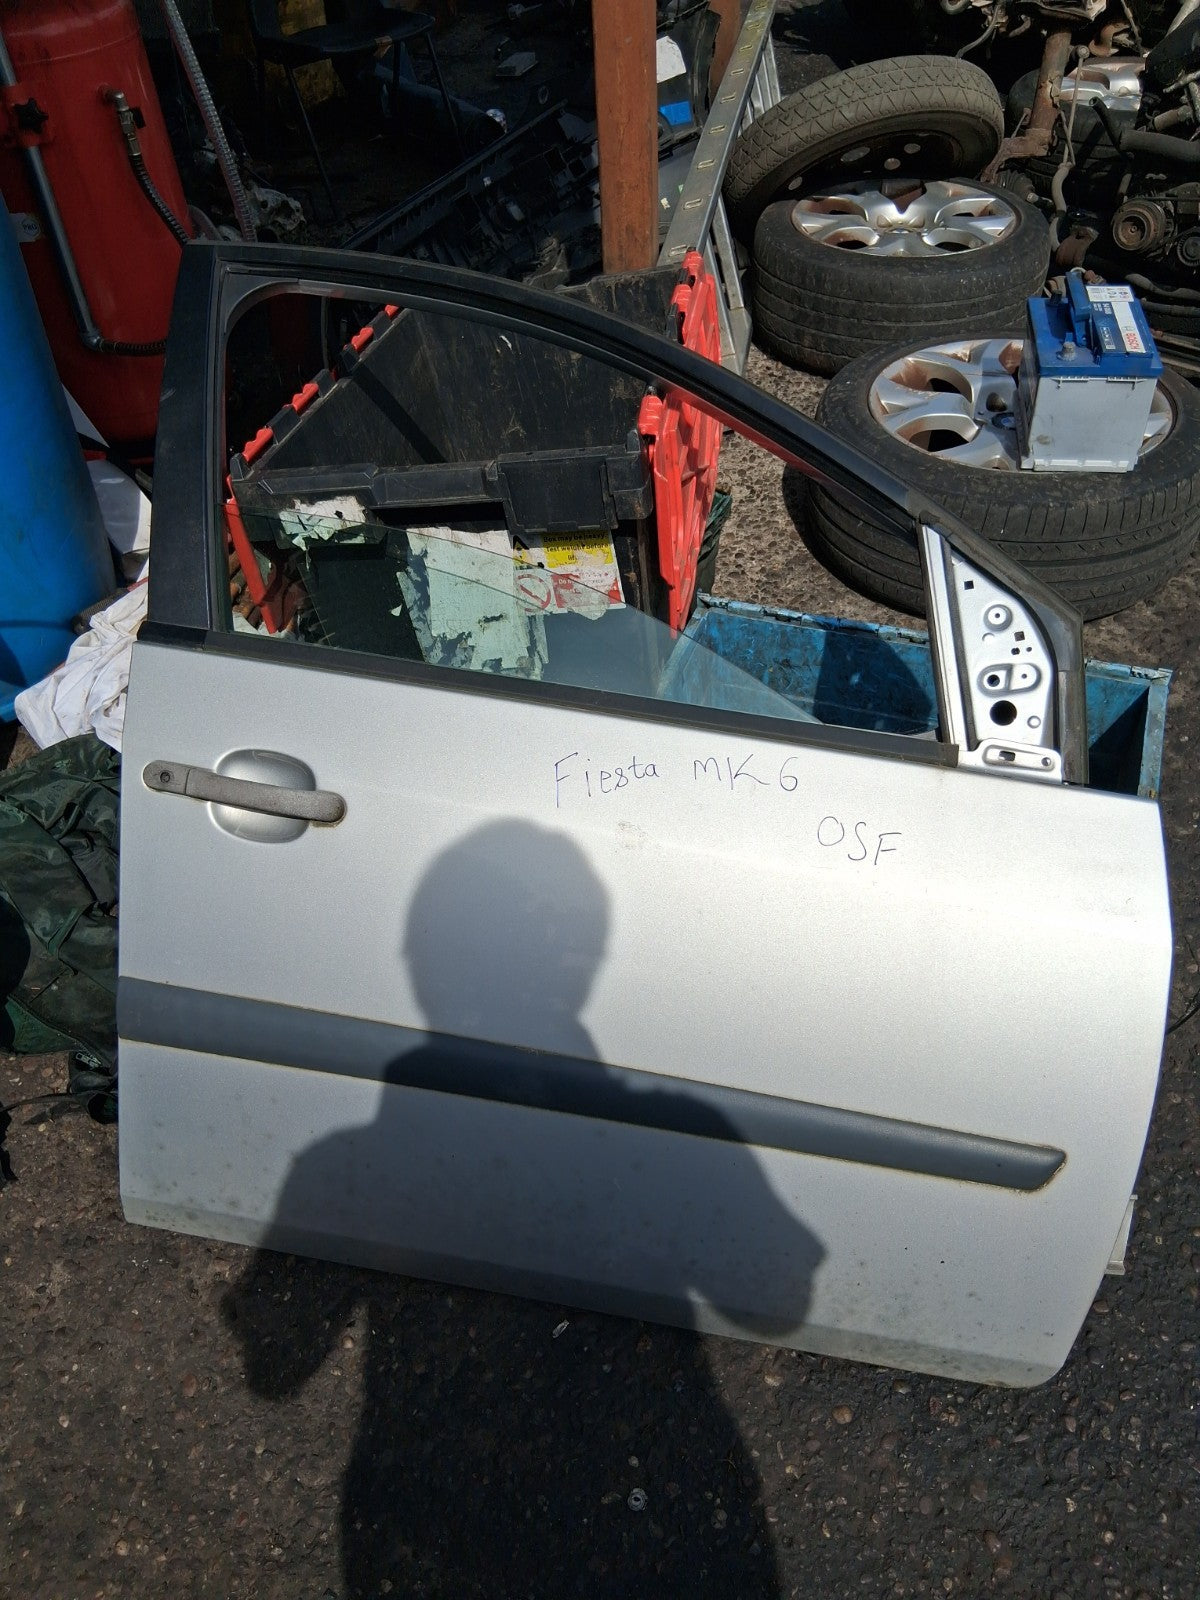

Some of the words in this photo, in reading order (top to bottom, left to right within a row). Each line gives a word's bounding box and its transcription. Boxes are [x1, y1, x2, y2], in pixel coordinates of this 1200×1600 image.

[1126, 333, 1141, 349] BOSCH
[561, 543, 585, 551] weight
[554, 752, 659, 808] Fiesta
[693, 753, 770, 790] MK
[779, 756, 799, 792] 6
[817, 815, 903, 866] OSF
